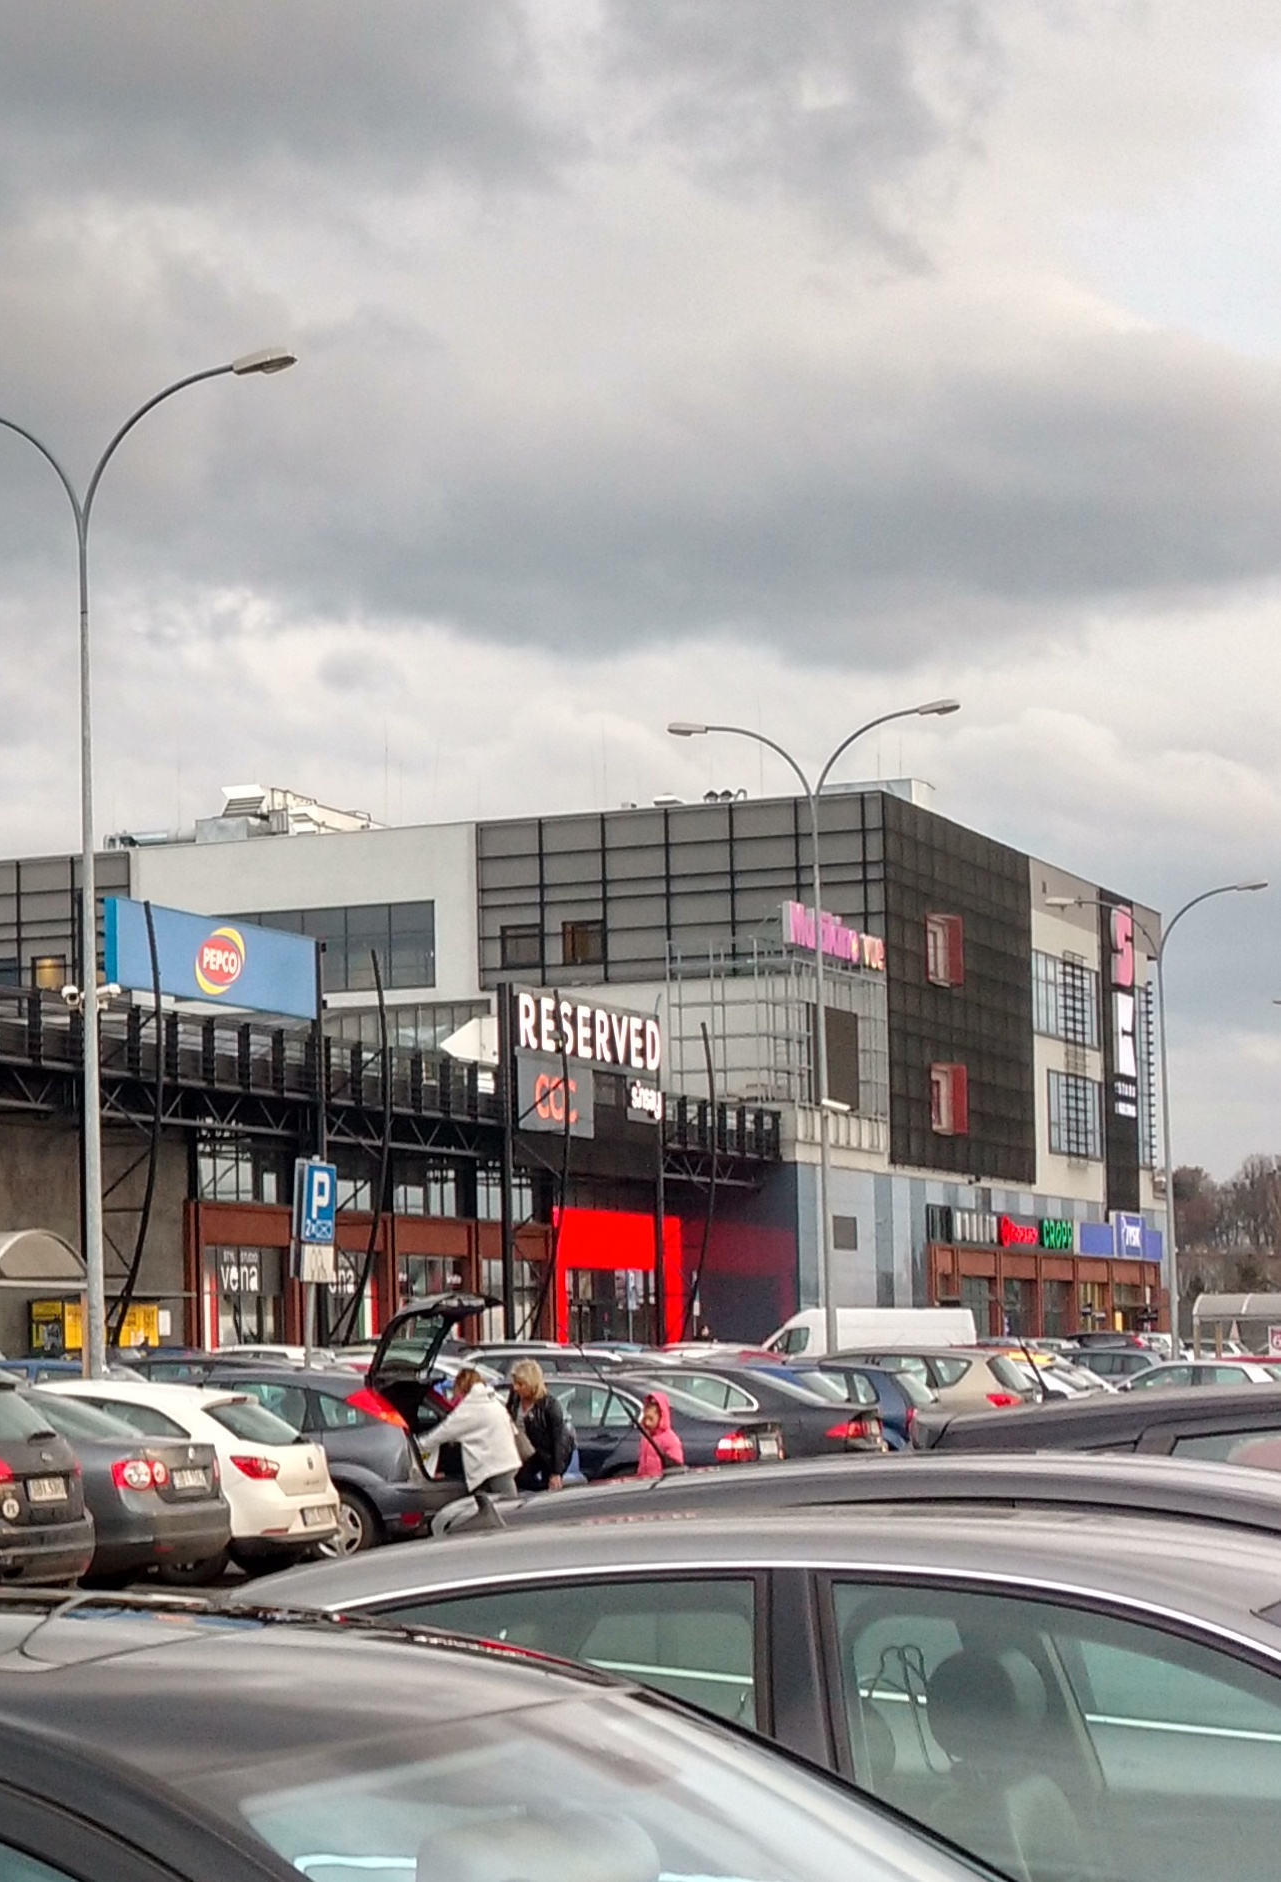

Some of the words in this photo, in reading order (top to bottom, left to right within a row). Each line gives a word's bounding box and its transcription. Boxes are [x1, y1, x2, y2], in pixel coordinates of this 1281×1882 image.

[202, 946, 238, 975] PEPCO
[519, 992, 661, 1071] RESERVED
[312, 1170, 330, 1220] P
[220, 1264, 259, 1293] vena
[328, 1269, 355, 1294] ena
